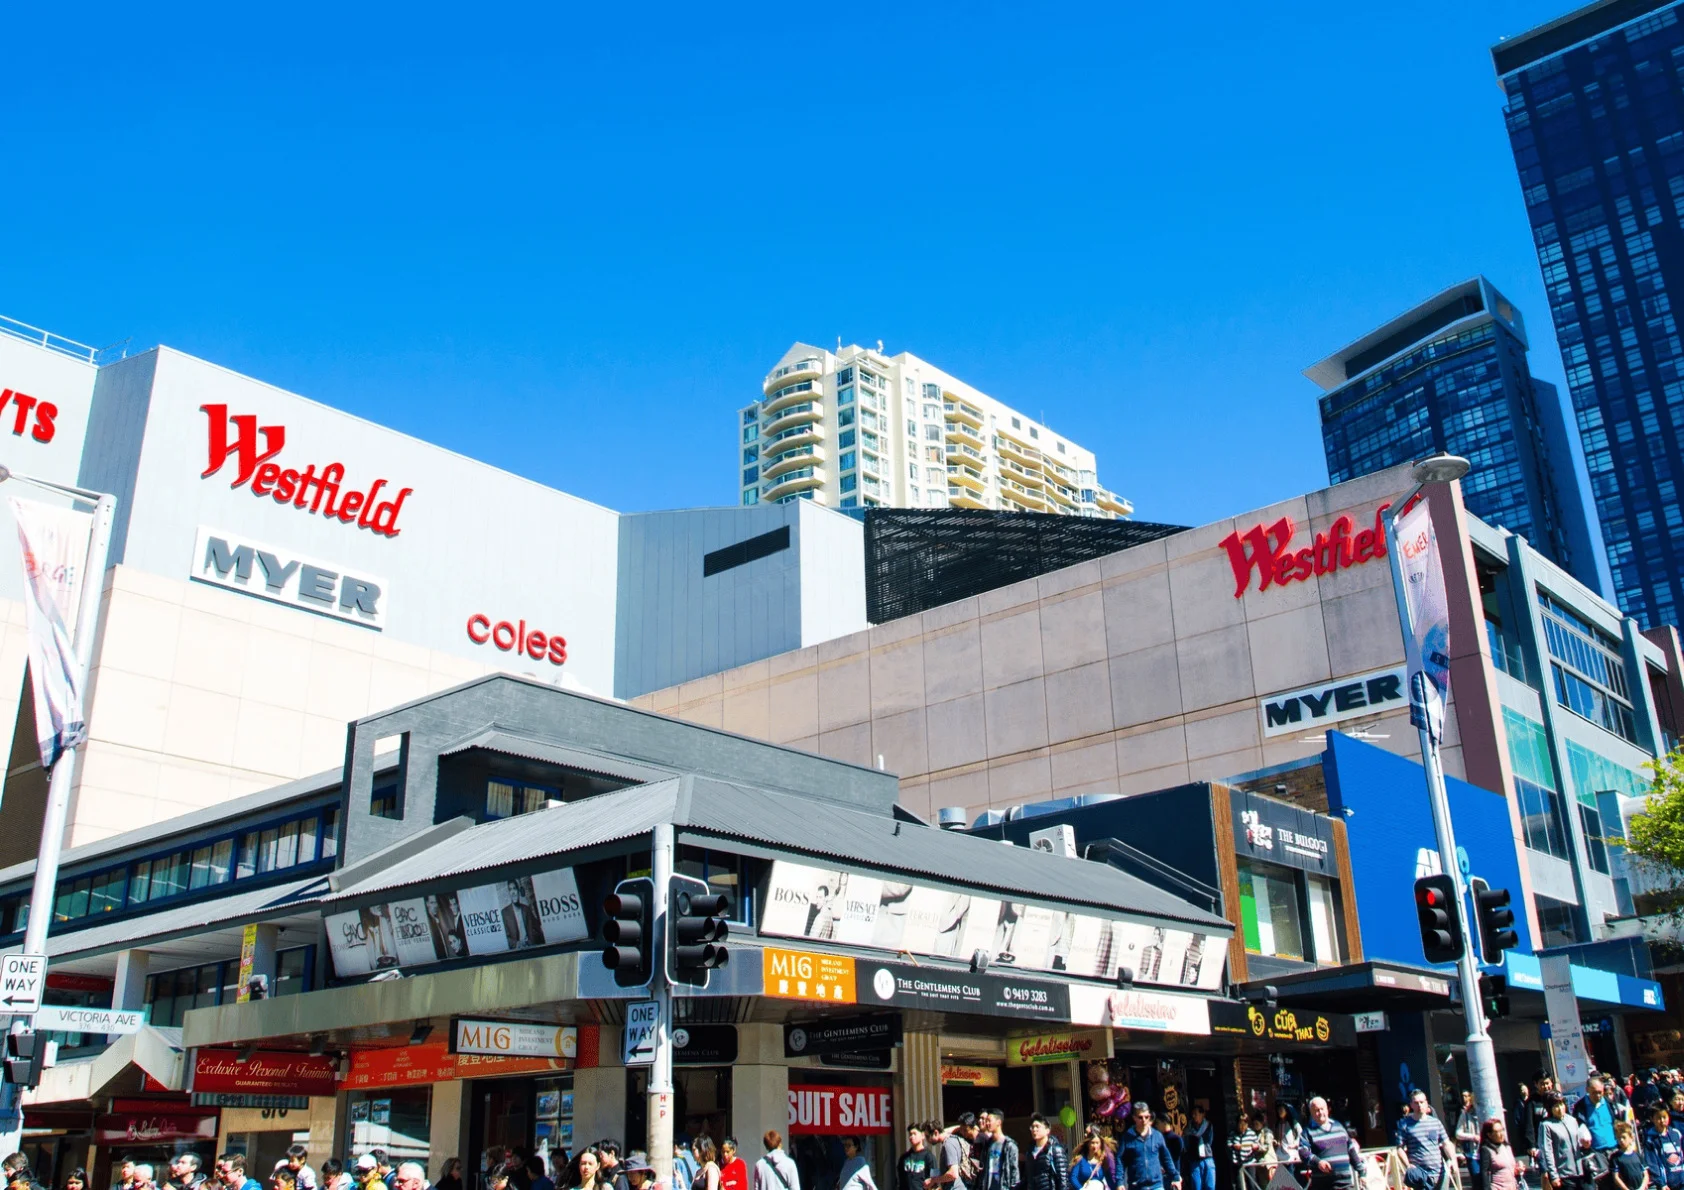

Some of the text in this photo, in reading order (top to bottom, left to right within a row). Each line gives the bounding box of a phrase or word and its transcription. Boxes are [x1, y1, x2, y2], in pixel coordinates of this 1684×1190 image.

[200, 404, 413, 537] Westfield
[205, 536, 382, 616] MYER
[467, 613, 567, 665] coles
[1265, 673, 1401, 728] MYER
[1277, 828, 1294, 844] THE
[1294, 833, 1328, 853] BULGOGI
[540, 893, 579, 917] BOSS
[774, 886, 810, 906] BOSS
[463, 908, 501, 928] VERSACE
[845, 900, 877, 915] VERSACE
[466, 926, 491, 937] CLASSIC
[9, 960, 38, 974] ONE
[771, 953, 812, 979] MIG
[5, 978, 37, 992] WAY
[897, 978, 912, 989] THE
[1012, 987, 1047, 1003] 9419 3283
[1108, 991, 1177, 1021] Gelatissimo
[59, 1010, 137, 1026] VICTORIA AVE
[631, 1006, 655, 1022] ONE
[461, 1025, 511, 1050] MIG
[629, 1026, 655, 1042] WAY
[1295, 1026, 1314, 1041] THAI
[1019, 1036, 1093, 1063] Gelatissimo
[196, 1057, 243, 1076] Exclusive
[245, 1059, 292, 1079] Personal
[294, 1062, 335, 1083] Training
[788, 1091, 891, 1128] SUIT SALE
